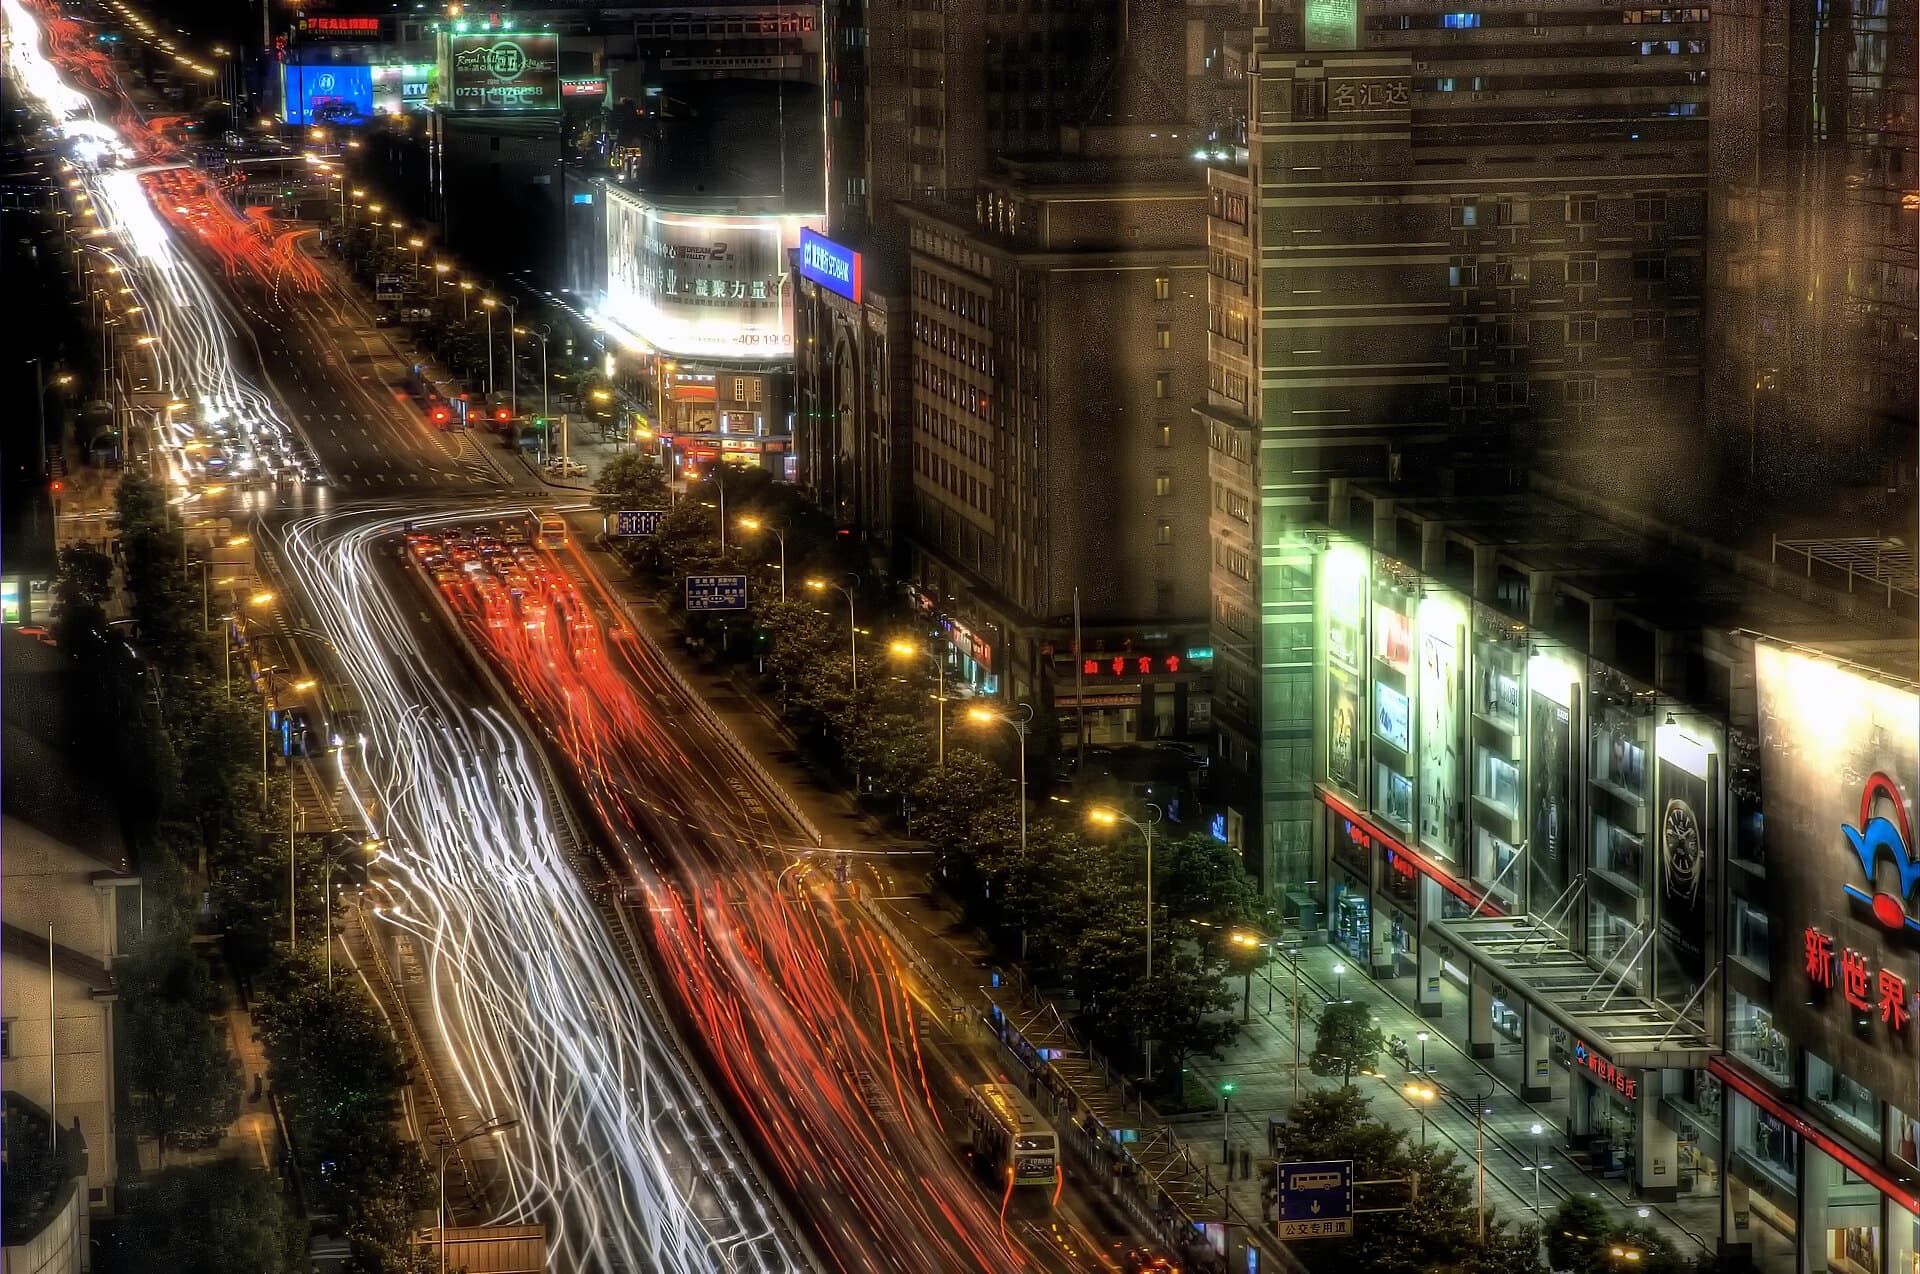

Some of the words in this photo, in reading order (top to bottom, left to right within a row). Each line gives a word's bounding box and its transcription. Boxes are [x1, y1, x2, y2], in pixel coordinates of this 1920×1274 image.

[403, 84, 427, 95] KTV
[1334, 82, 1408, 106] 名汇达
[695, 279, 766, 299] 凝聚力量
[1805, 927, 1920, 1031] 新世界
[1589, 1052, 1635, 1100] 新世界百货
[1286, 1222, 1346, 1235] 公交专用道
